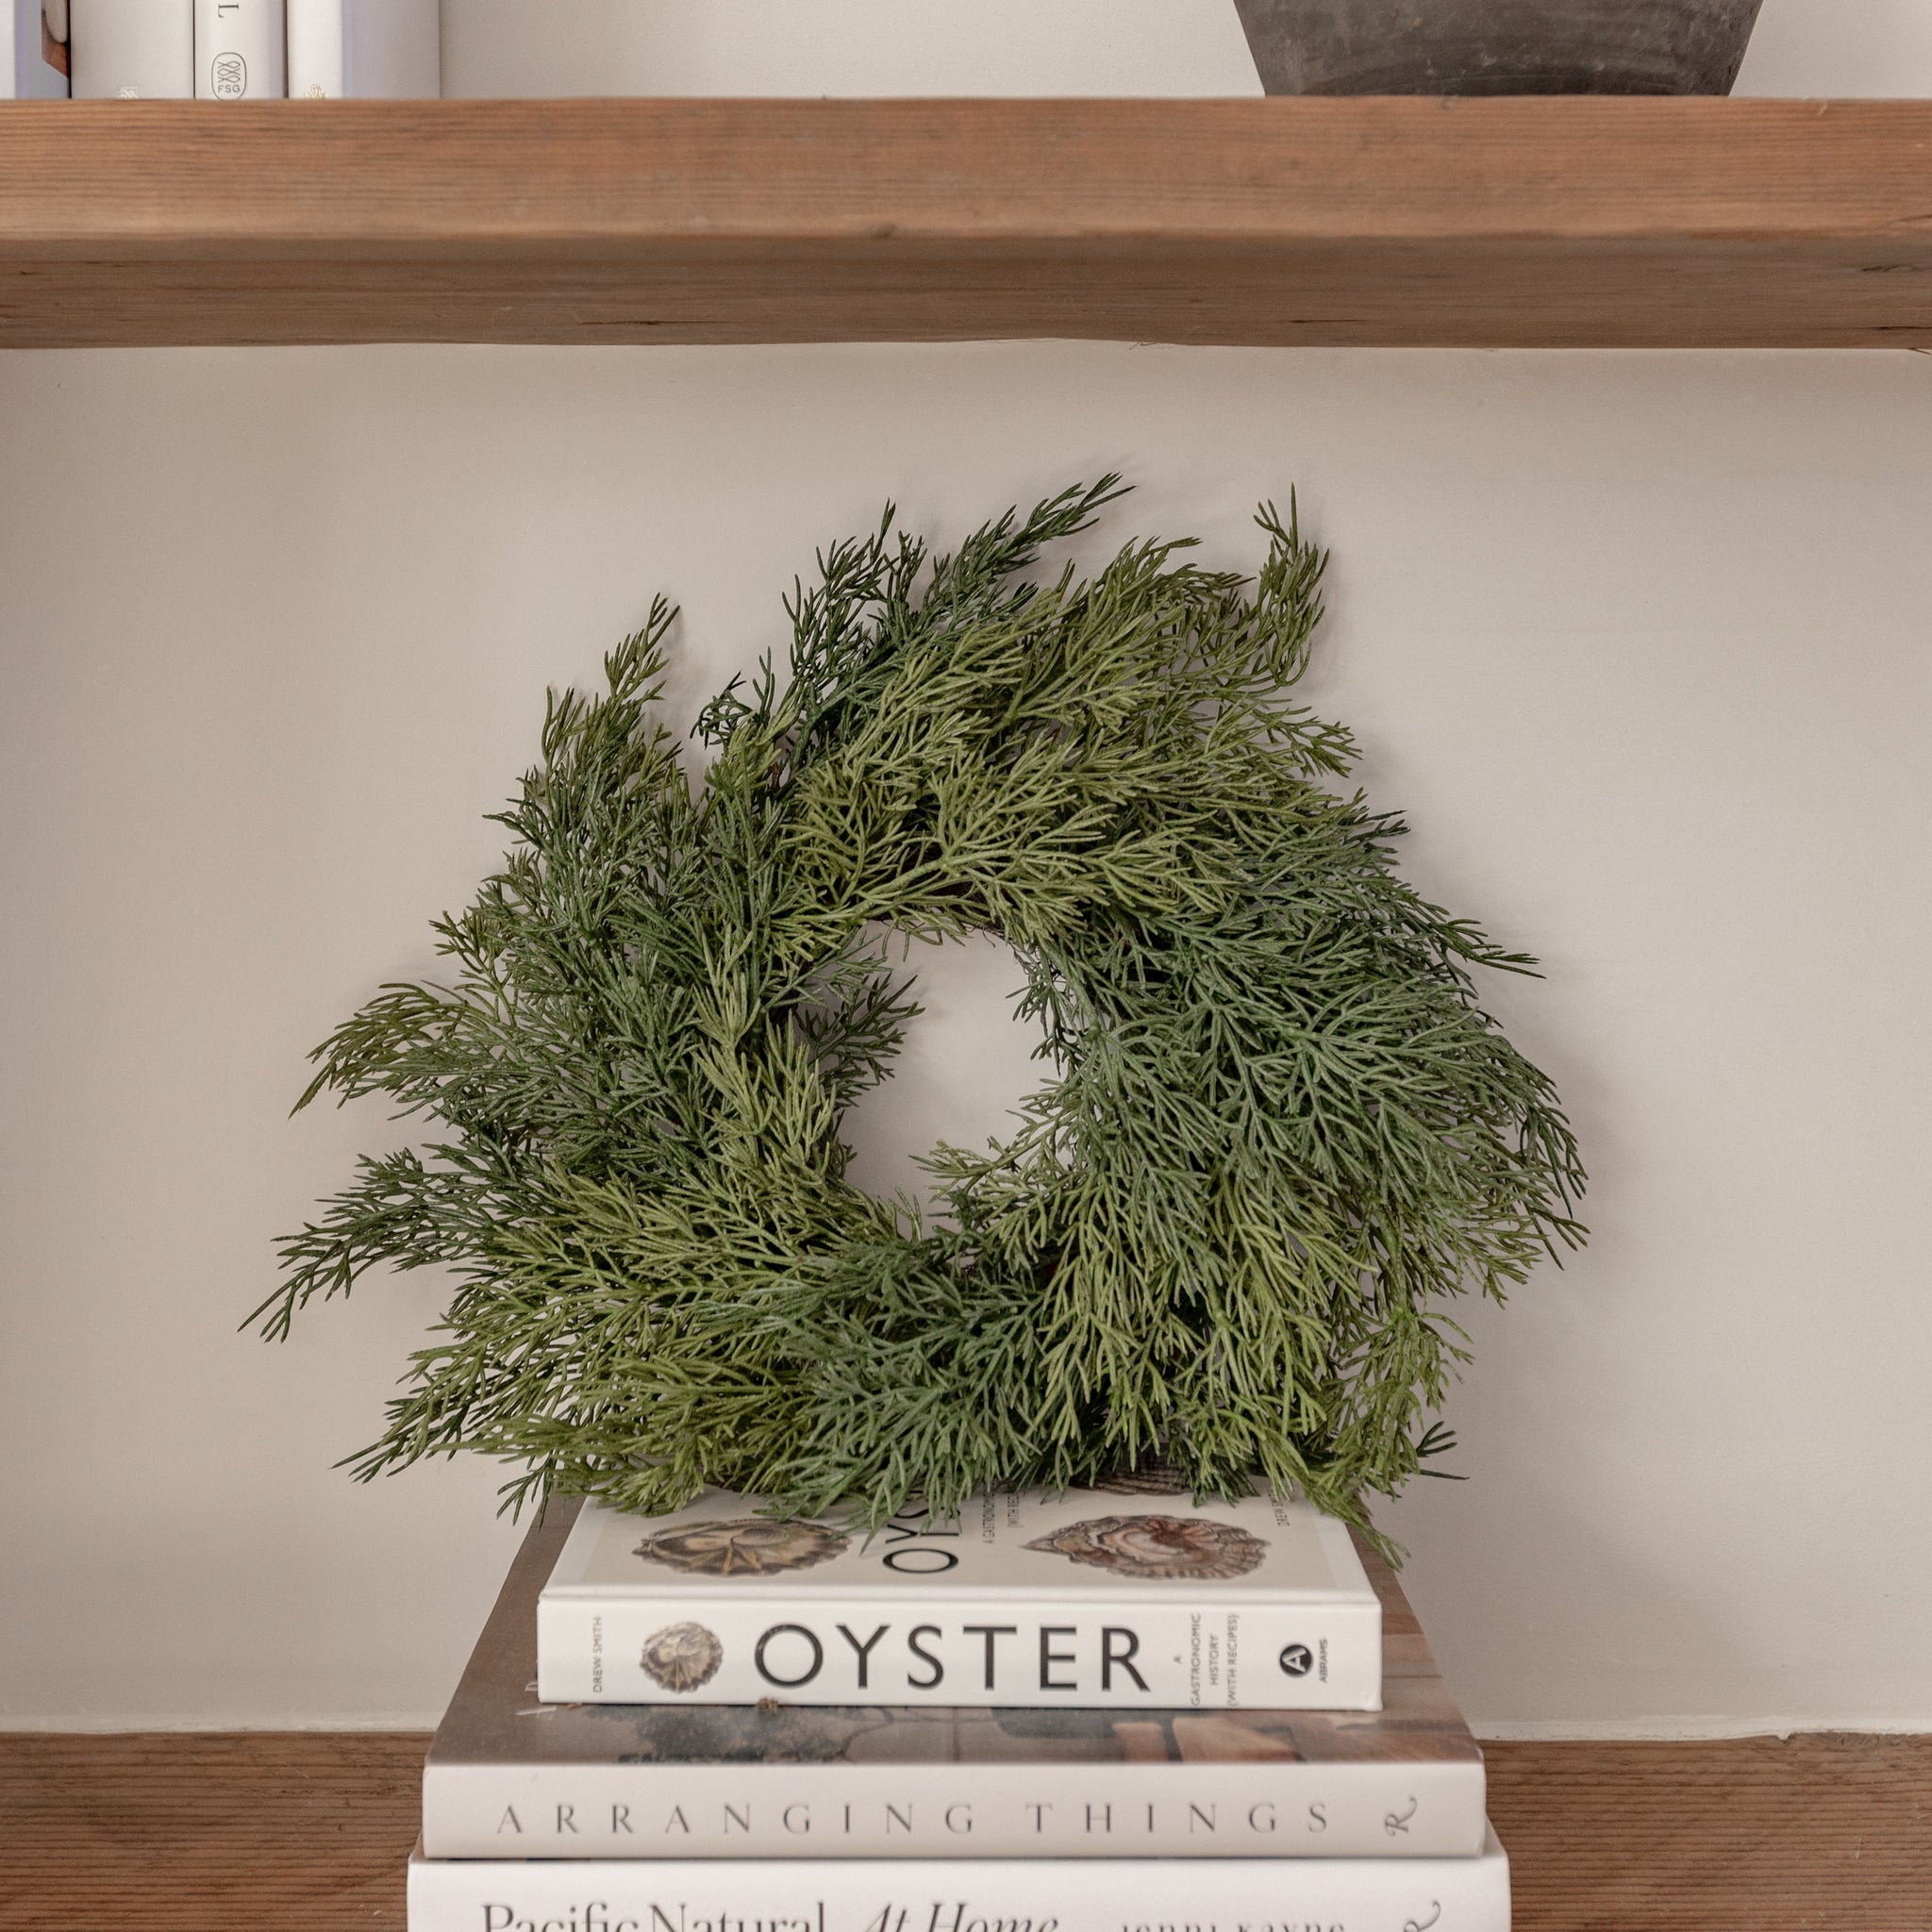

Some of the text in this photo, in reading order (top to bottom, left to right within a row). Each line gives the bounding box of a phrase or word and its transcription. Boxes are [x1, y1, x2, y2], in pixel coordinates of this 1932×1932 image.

[217, 84, 241, 93] FSG
[592, 1616, 603, 1693] DREW SMITH
[754, 1624, 1152, 1692] OYSTER
[1173, 1656, 1182, 1665] A
[1191, 1613, 1202, 1707] GASTRONOMIC
[1208, 1635, 1220, 1686] HISTORY
[1319, 1638, 1328, 1684] ABRAMS
[496, 1804, 1327, 1835] ARRANGING THINGS
